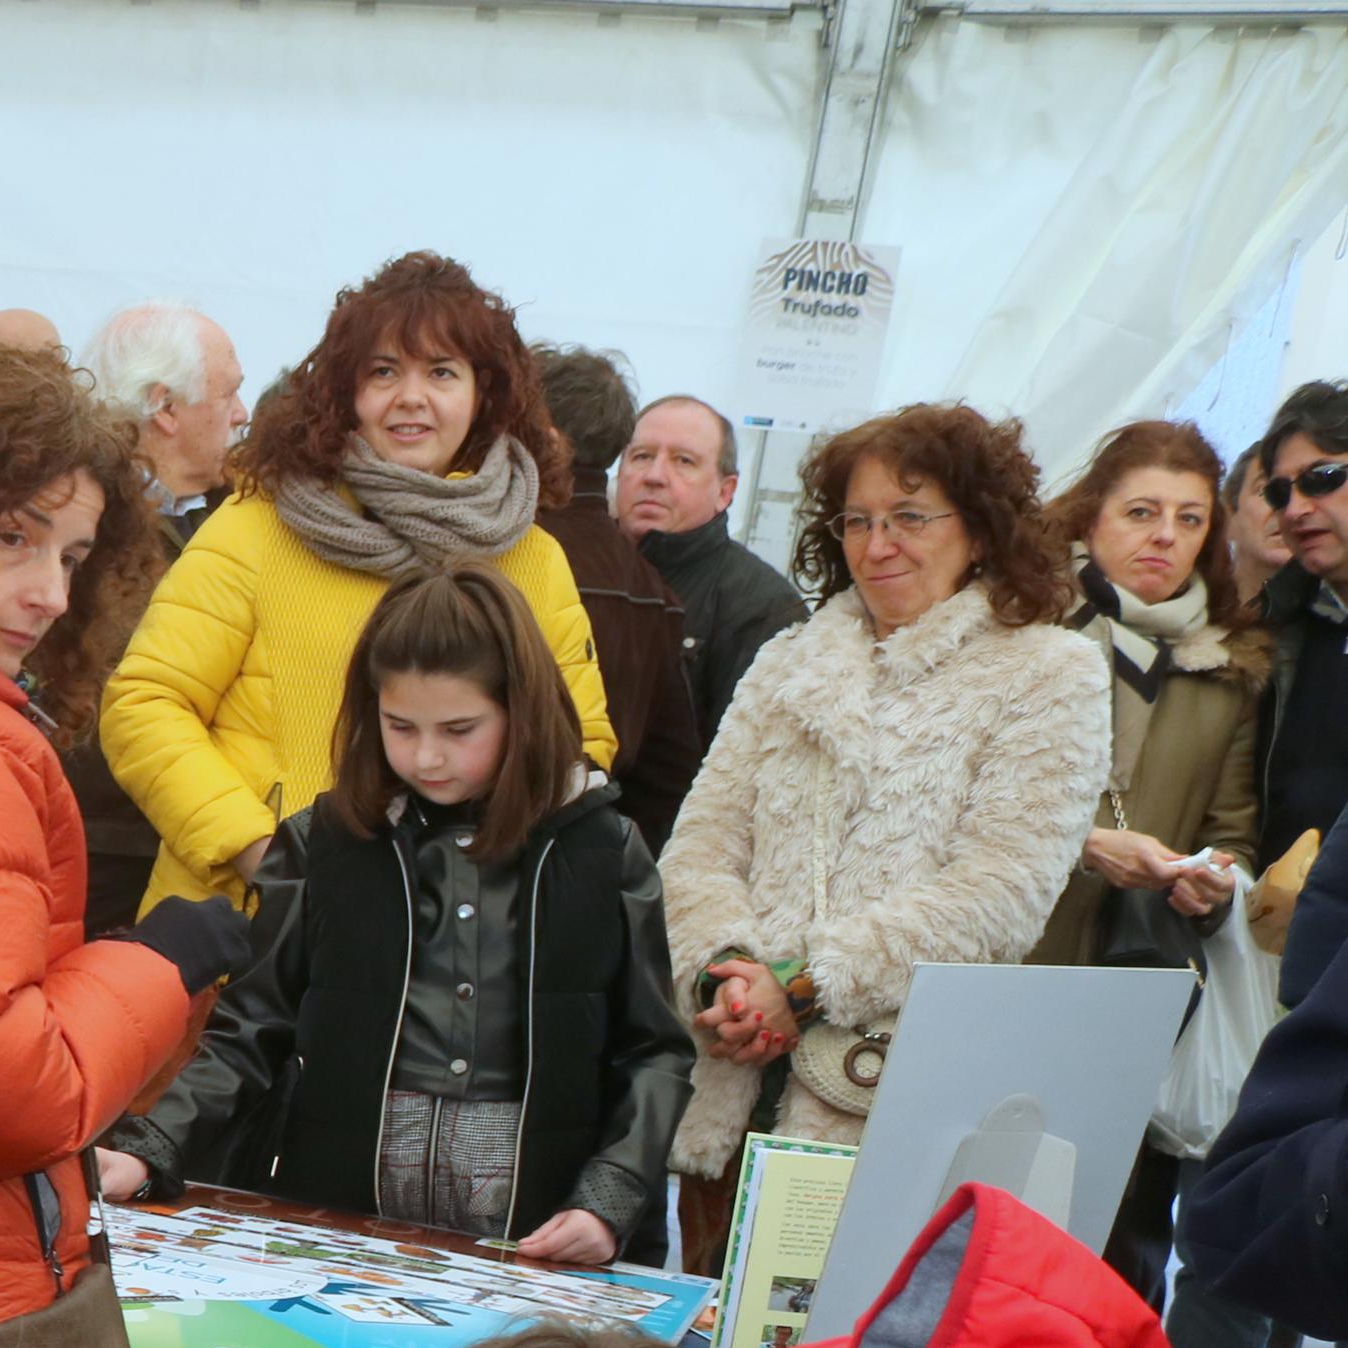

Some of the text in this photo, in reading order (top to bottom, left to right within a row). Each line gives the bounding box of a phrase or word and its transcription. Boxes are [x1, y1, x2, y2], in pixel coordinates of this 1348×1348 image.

[782, 268, 869, 296] PINCHO
[782, 298, 860, 318] Trufado
[756, 358, 796, 371] burger
